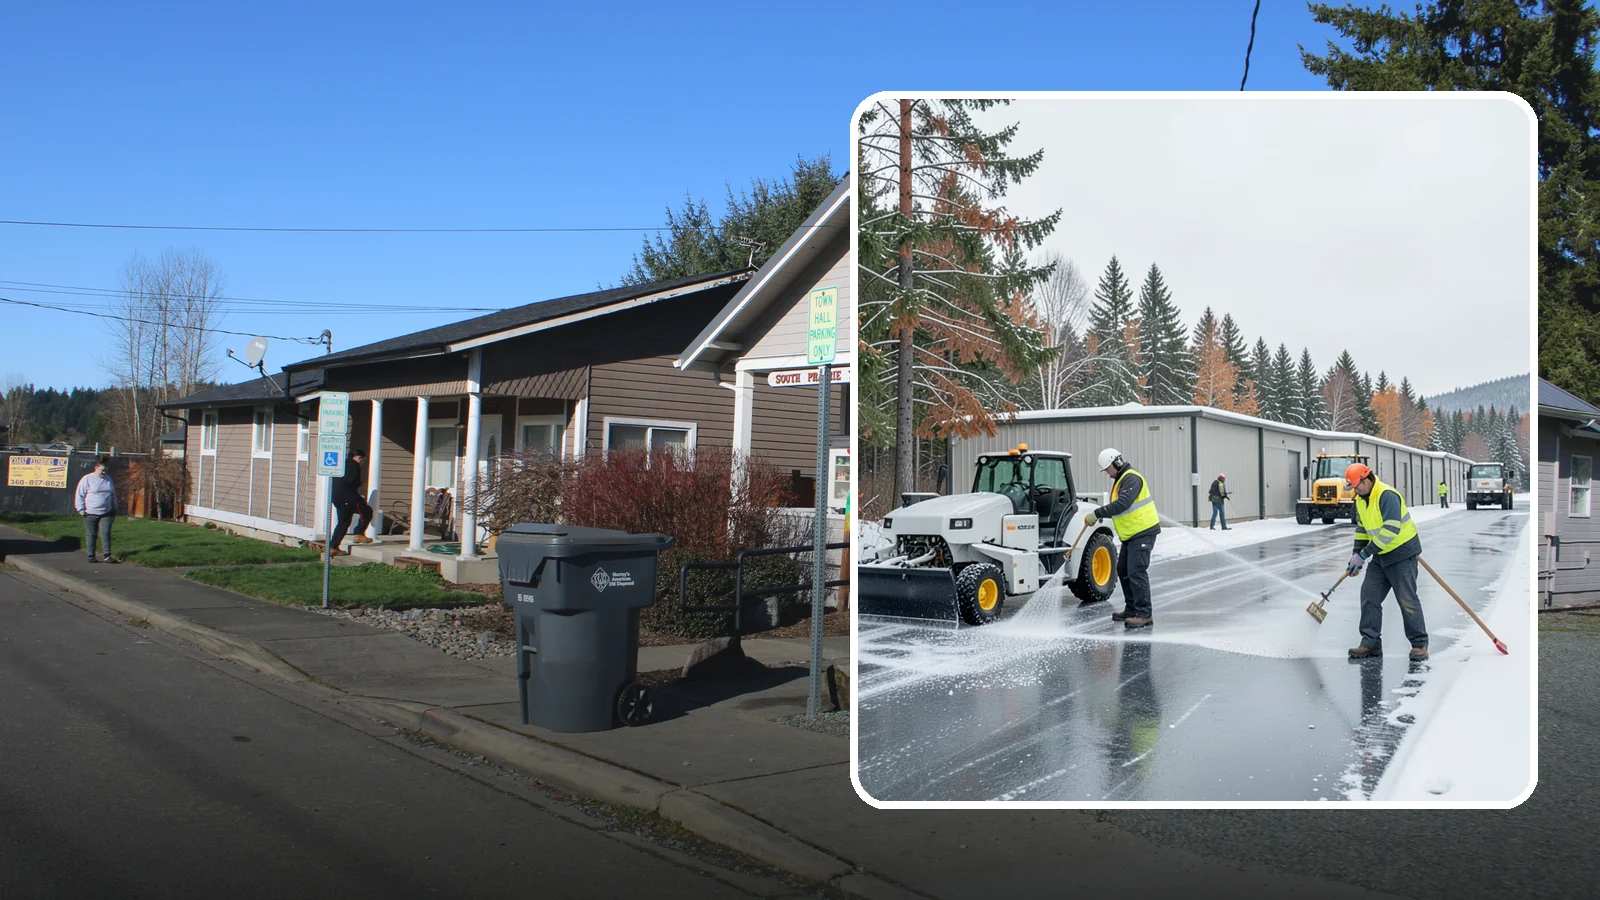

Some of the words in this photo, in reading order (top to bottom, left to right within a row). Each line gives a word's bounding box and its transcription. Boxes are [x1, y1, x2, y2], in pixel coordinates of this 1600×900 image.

[815, 295, 833, 308] TOWN
[814, 312, 831, 324] HALL
[810, 327, 835, 340] PARKING
[813, 344, 831, 357] ONLY
[775, 373, 801, 384] SOUTH
